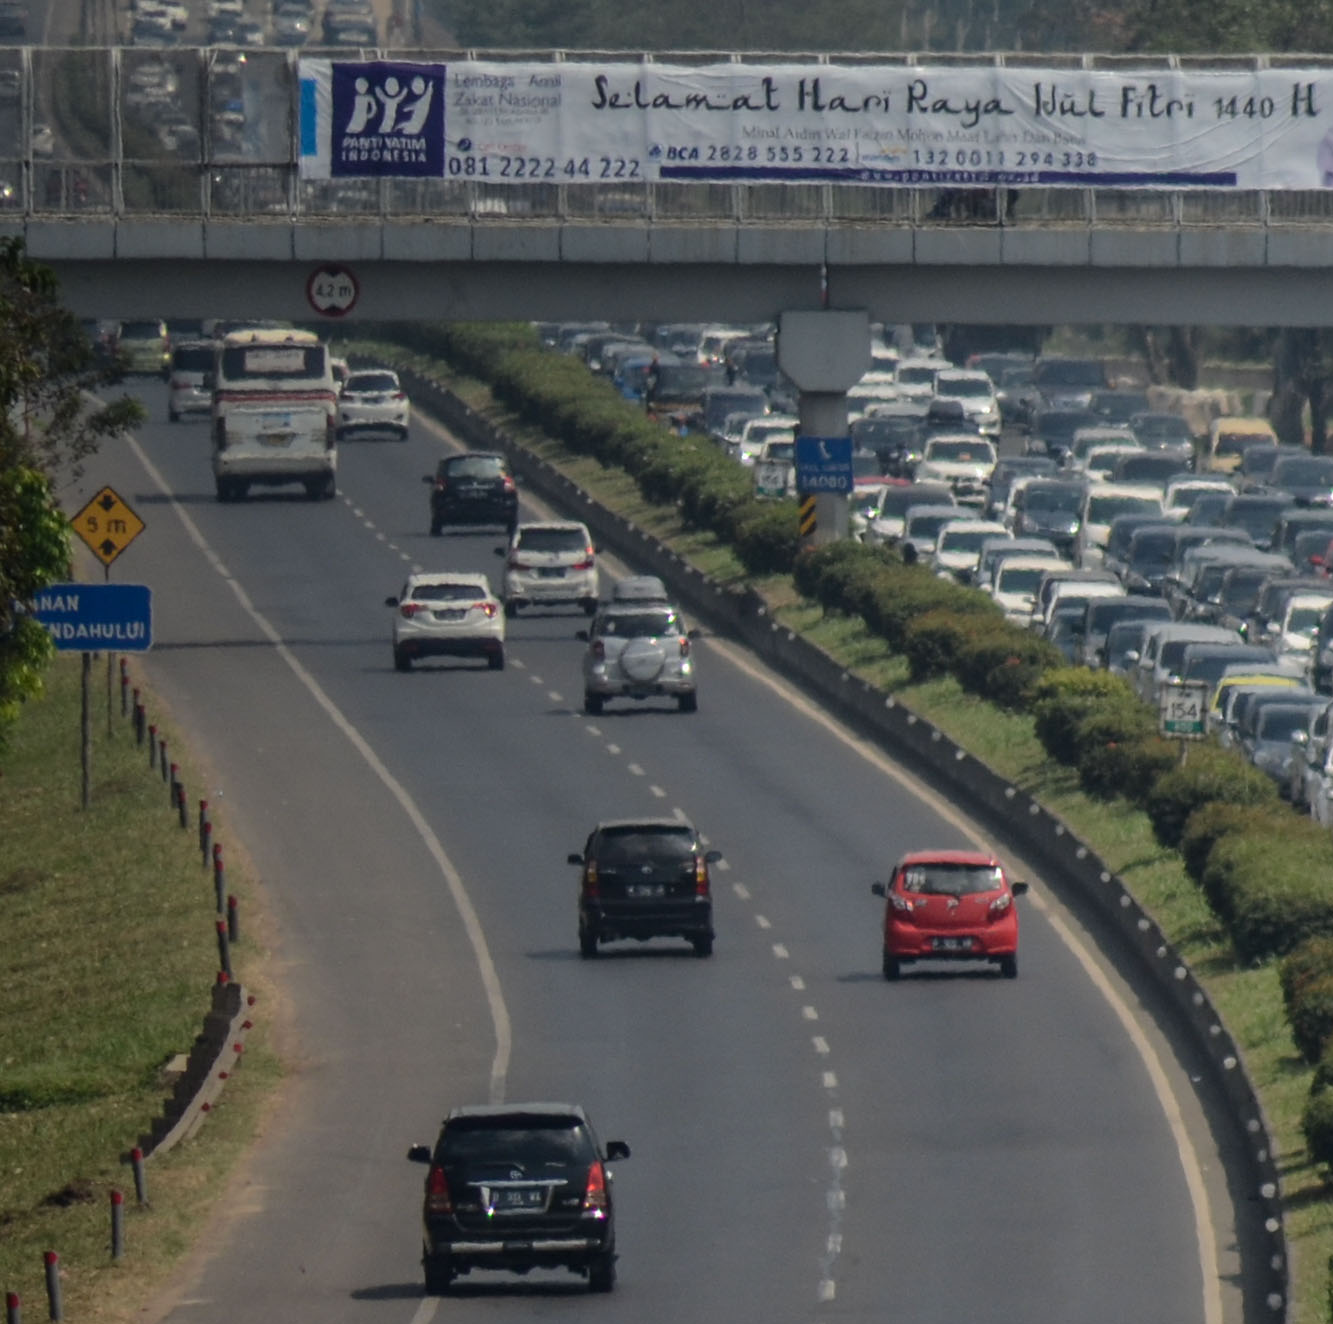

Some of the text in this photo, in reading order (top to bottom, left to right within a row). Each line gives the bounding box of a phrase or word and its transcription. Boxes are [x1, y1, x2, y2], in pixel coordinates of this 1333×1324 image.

[454, 73, 562, 90] Lembaga Amil
[454, 92, 562, 108] Zakat Nasional
[592, 75, 780, 112] Selamat
[797, 78, 890, 113] Hari
[907, 79, 1014, 128] Raya
[1121, 84, 1195, 119] Fitri
[1213, 95, 1274, 119] 1440
[1291, 82, 1321, 118] H
[743, 126, 780, 140] Minal
[342, 137, 426, 150] PANTI YATIM
[342, 151, 427, 162] INDONESIA
[667, 146, 699, 161] BCA
[708, 145, 758, 161] 2828
[766, 146, 803, 162] 555
[812, 147, 850, 162] 222
[913, 149, 949, 165] 132
[956, 150, 1004, 167] 0011
[1015, 151, 1054, 167] 294
[1061, 152, 1098, 167] 338
[450, 156, 641, 178] 081 2222 44 222
[339, 286, 352, 297] m
[86, 516, 127, 534] 5 m
[40, 622, 145, 640] NDAHULUI
